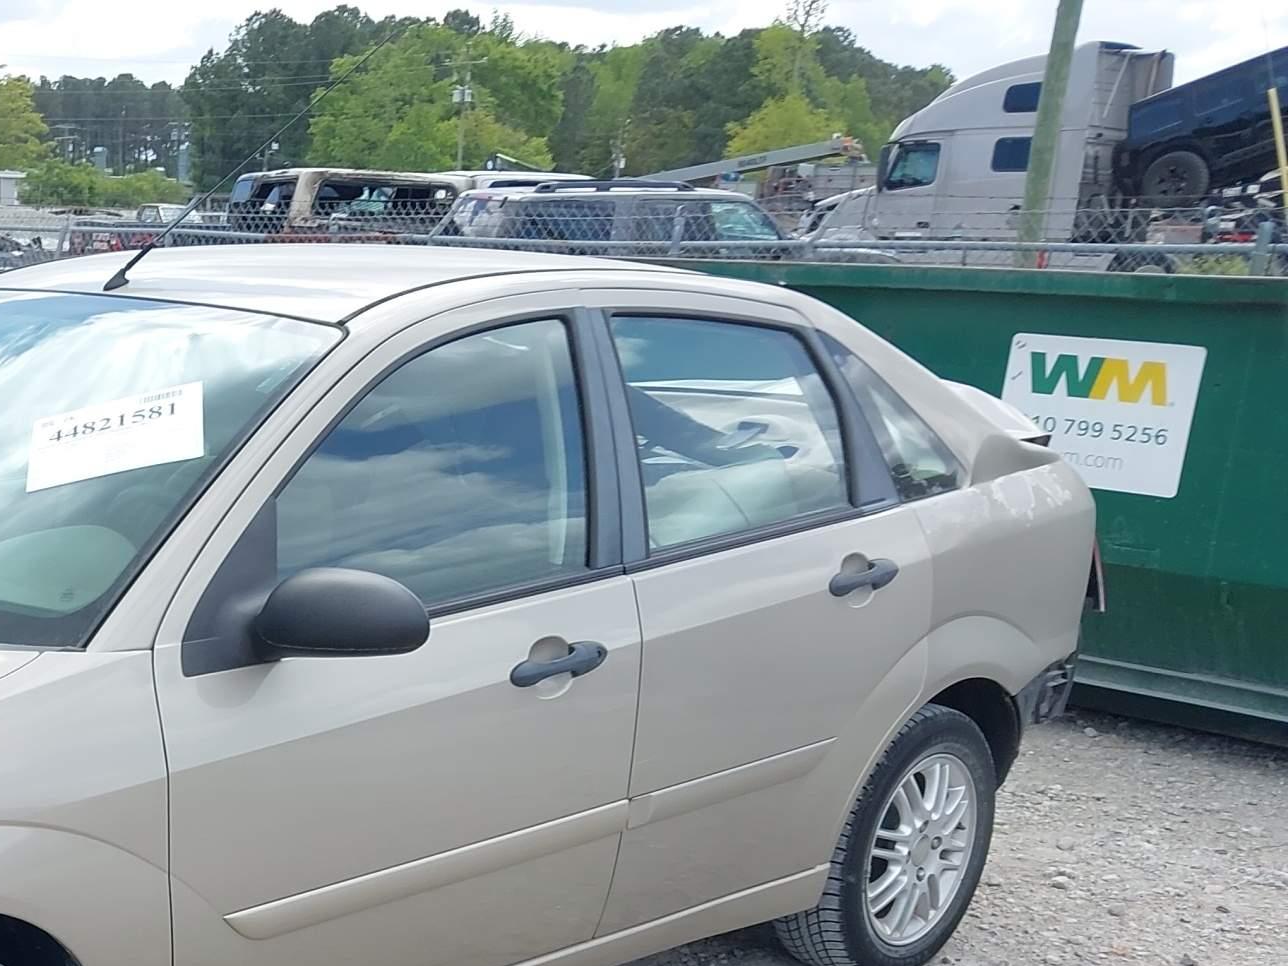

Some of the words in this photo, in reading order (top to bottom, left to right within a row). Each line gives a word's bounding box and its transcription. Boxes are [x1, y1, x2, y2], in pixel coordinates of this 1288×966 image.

[1030, 351, 1167, 407] WM
[49, 402, 177, 442] 44821581
[1024, 413, 1057, 433] 10
[1064, 418, 1104, 438] 799
[1109, 424, 1169, 446] 5256
[1063, 451, 1125, 470] m.com
